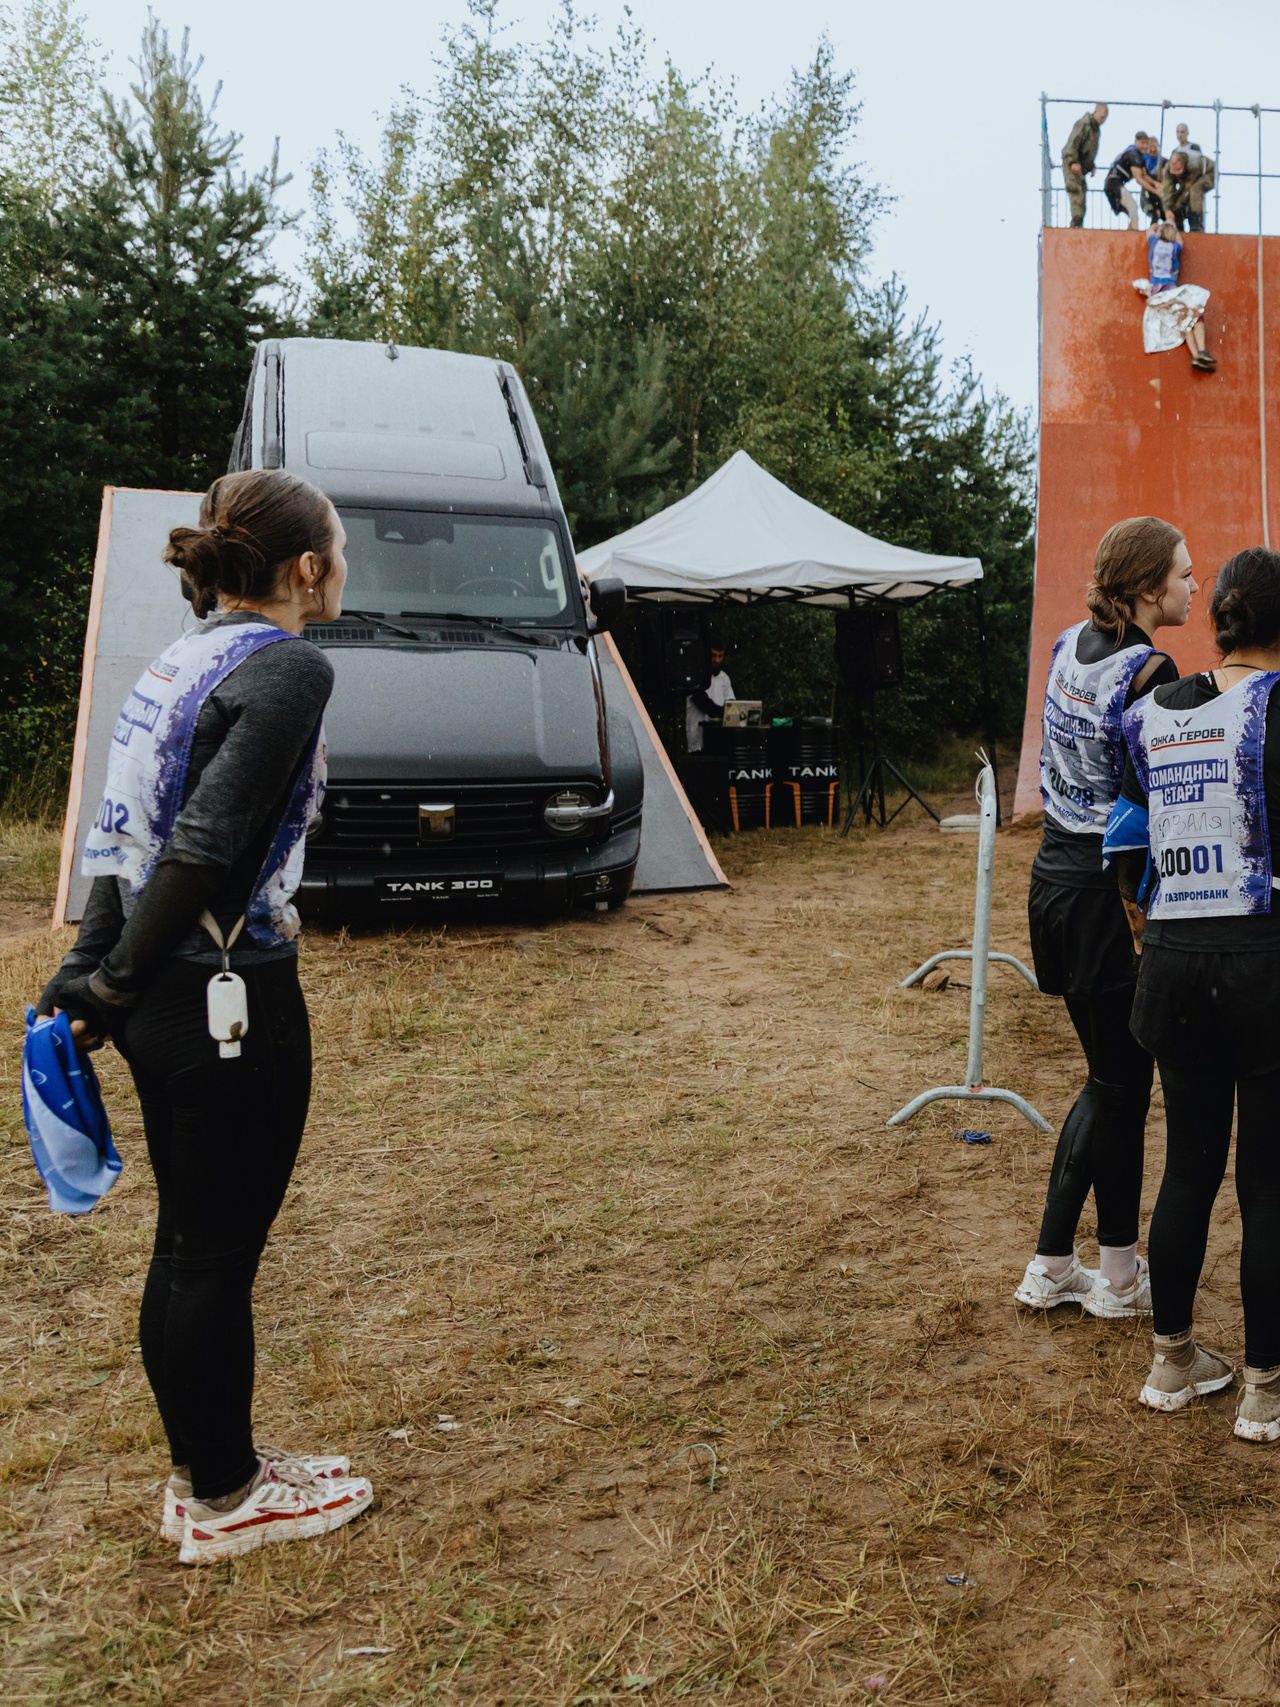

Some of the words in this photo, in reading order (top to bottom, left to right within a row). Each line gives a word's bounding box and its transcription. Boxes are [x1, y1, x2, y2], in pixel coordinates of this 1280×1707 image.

[1180, 727, 1225, 742] ГЕРОЕВ
[788, 766, 838, 778] TANK
[1164, 784, 1201, 804] СТАРТ
[387, 881, 445, 892] TANK
[451, 879, 493, 890] 300
[1165, 888, 1229, 903] ГАЗПРОМБАНК
